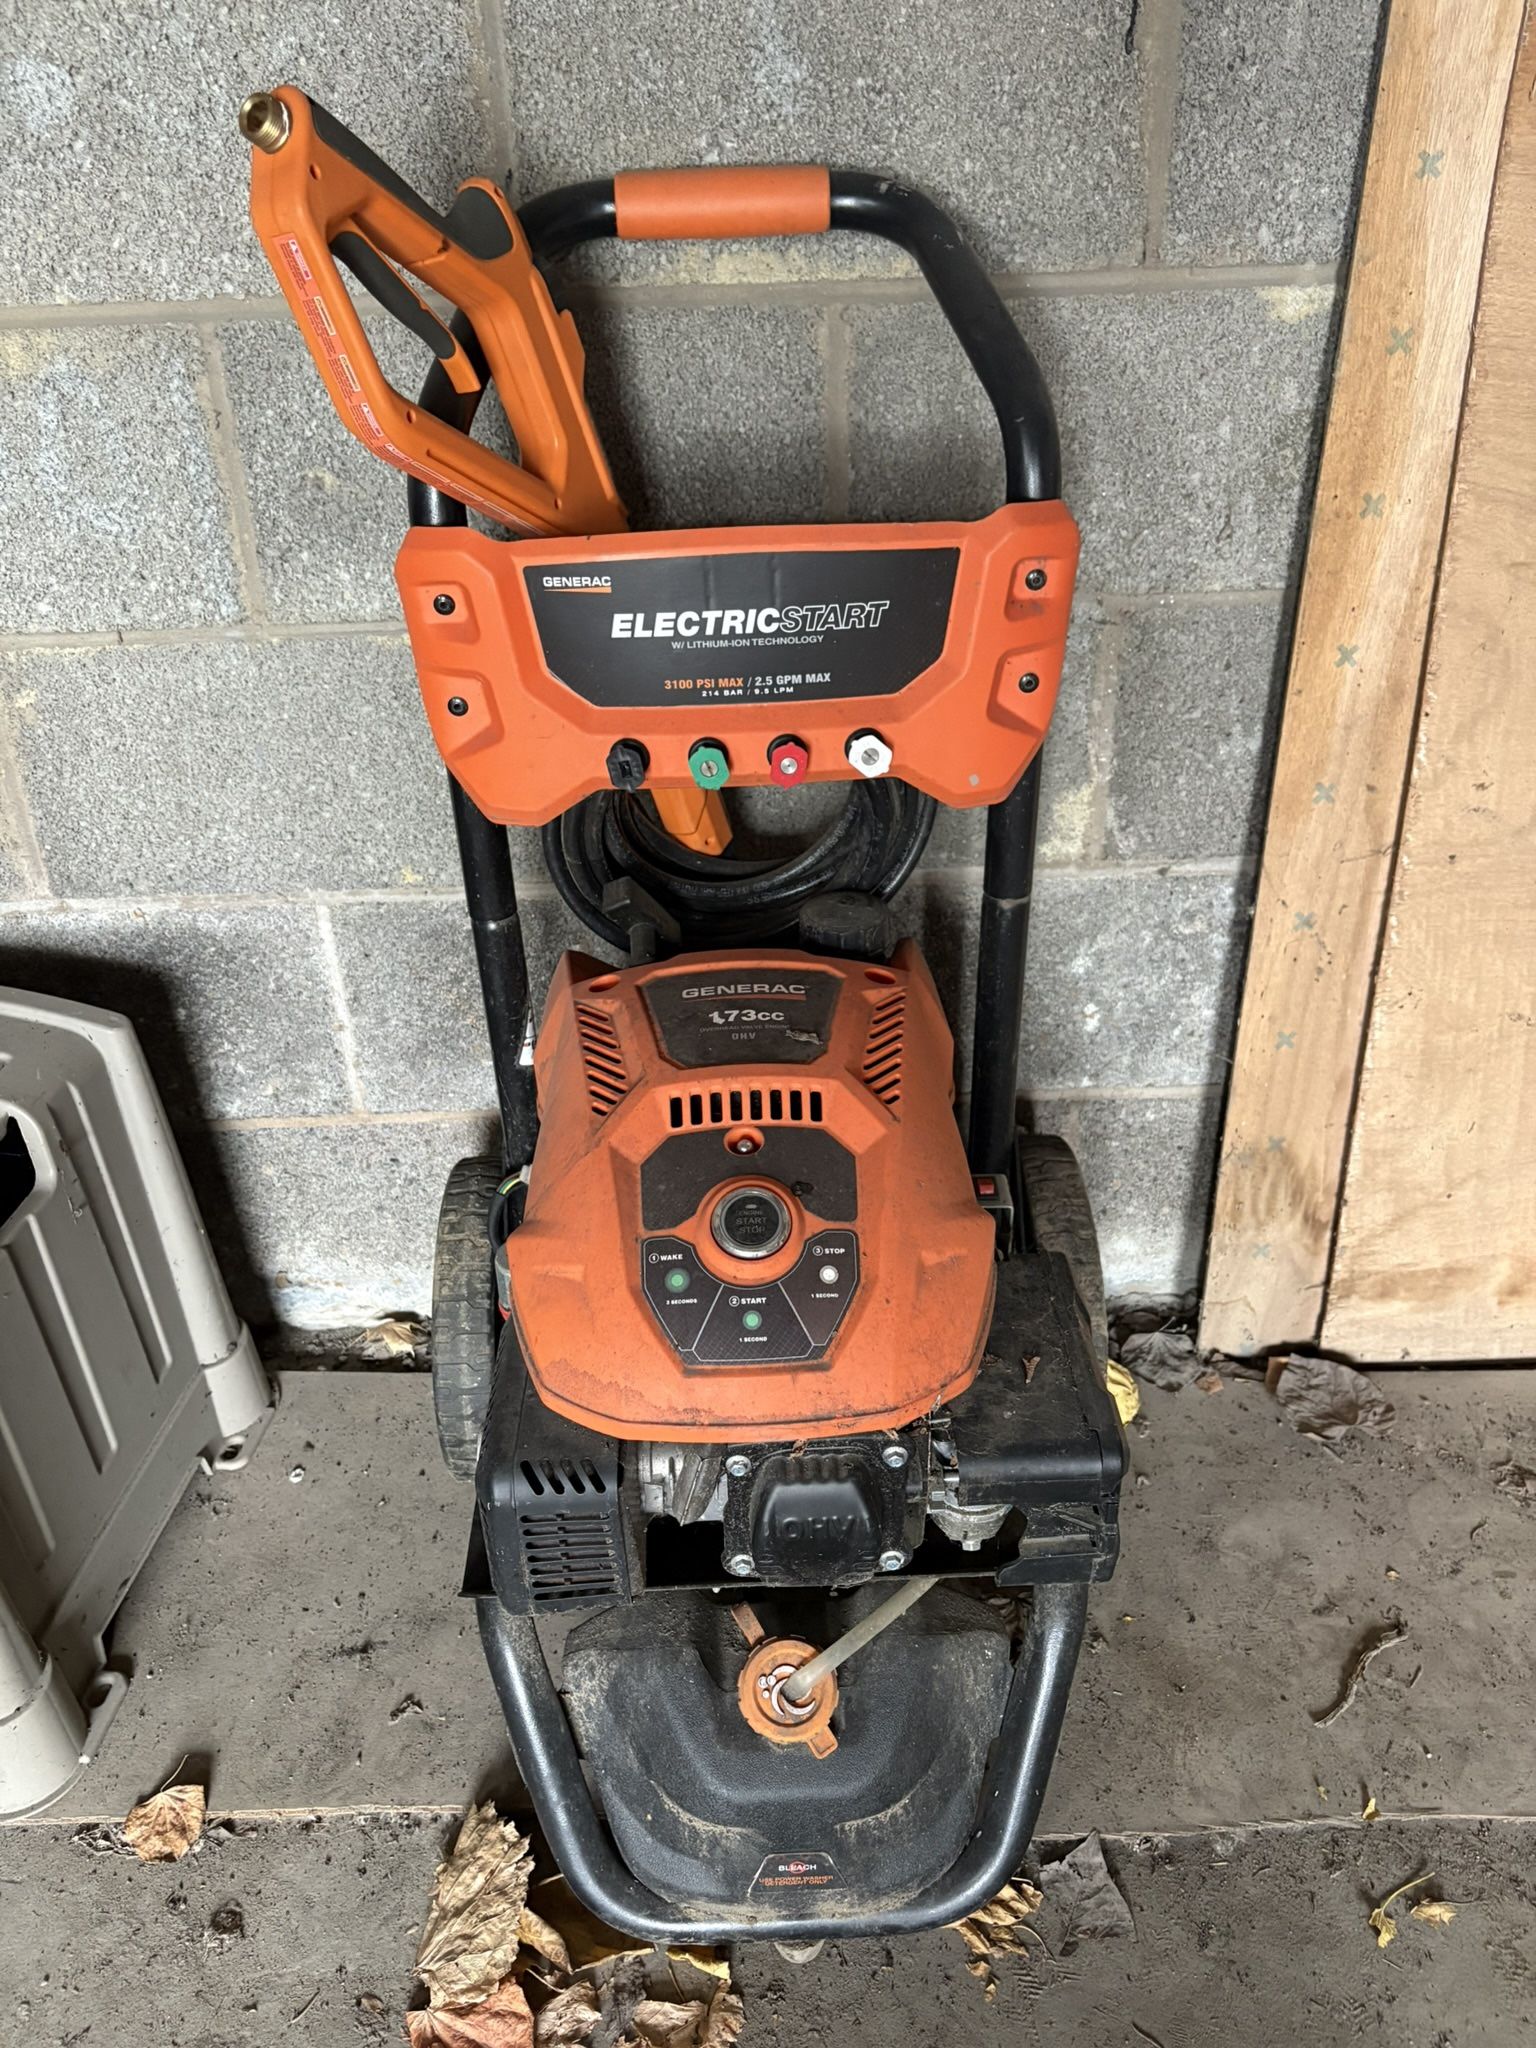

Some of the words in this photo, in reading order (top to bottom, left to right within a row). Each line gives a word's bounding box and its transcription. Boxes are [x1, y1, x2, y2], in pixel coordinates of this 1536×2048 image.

[543, 576, 612, 587] GENERAC
[611, 600, 890, 639] ELECTRICSTART
[671, 641, 685, 650] W/
[686, 637, 750, 649] LITHIUM-ION
[751, 635, 825, 647] TECHNOLOGY
[664, 679, 693, 690] 3100
[696, 679, 715, 689] PSI
[718, 677, 744, 688] MAX
[754, 676, 773, 686] 2.5
[776, 674, 803, 685] GPM
[805, 672, 832, 684] MAX
[723, 688, 743, 696] BAR
[774, 686, 794, 694] LPM
[682, 984, 806, 999] GENERAC
[732, 1032, 757, 1040] OHV
[735, 1216, 768, 1225] START
[660, 1253, 683, 1261] WAKE
[740, 1297, 767, 1305] START
[782, 1516, 855, 1540] OHV
[778, 1864, 817, 1872] BLEACH
